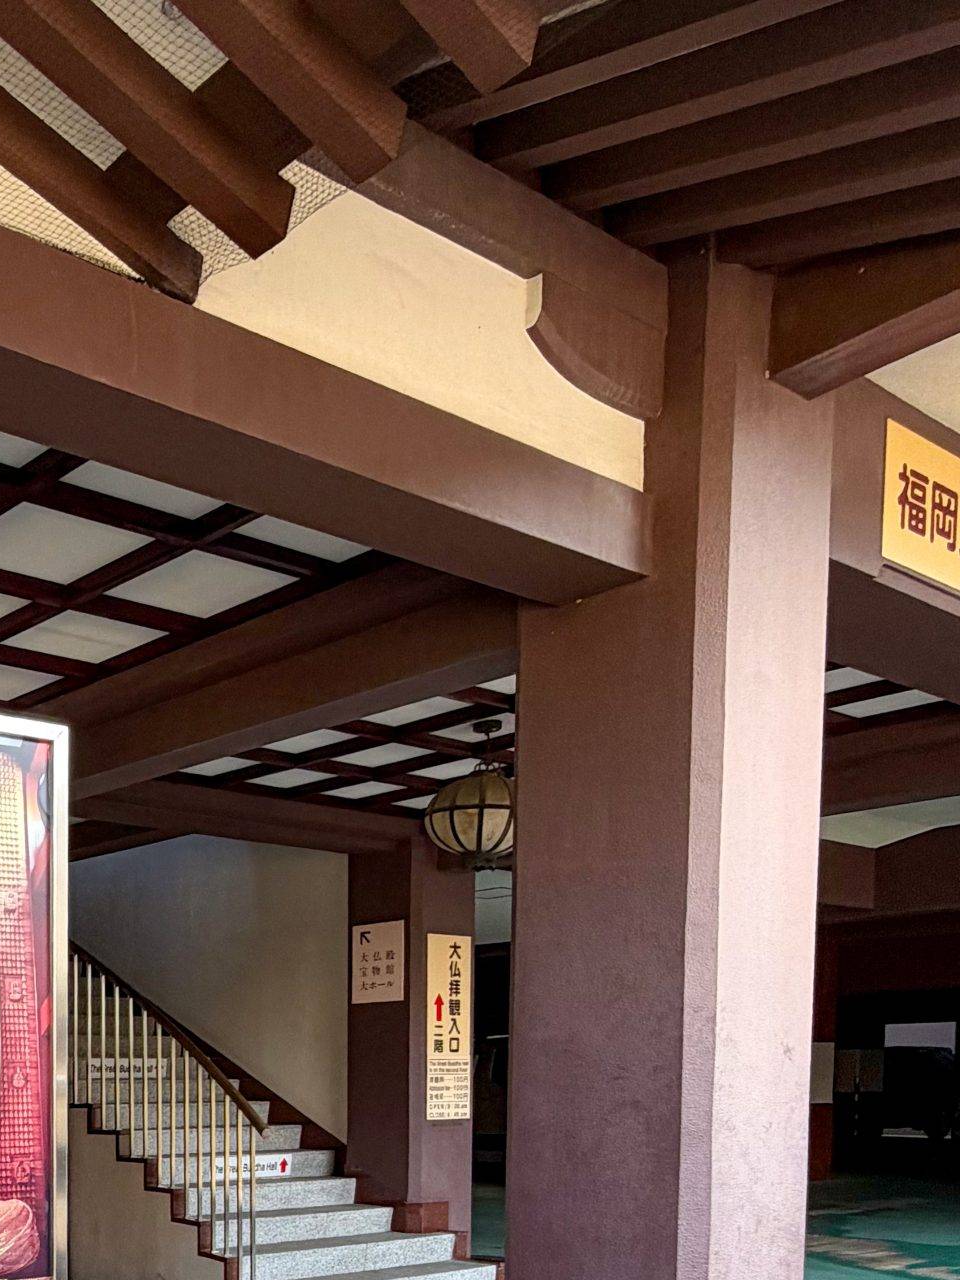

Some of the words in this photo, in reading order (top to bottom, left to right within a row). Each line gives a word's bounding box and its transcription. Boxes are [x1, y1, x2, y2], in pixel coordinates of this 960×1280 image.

[897, 462, 960, 552] 福岡
[433, 1025, 444, 1053] 二階
[448, 941, 461, 1053] 大仏拝観入口
